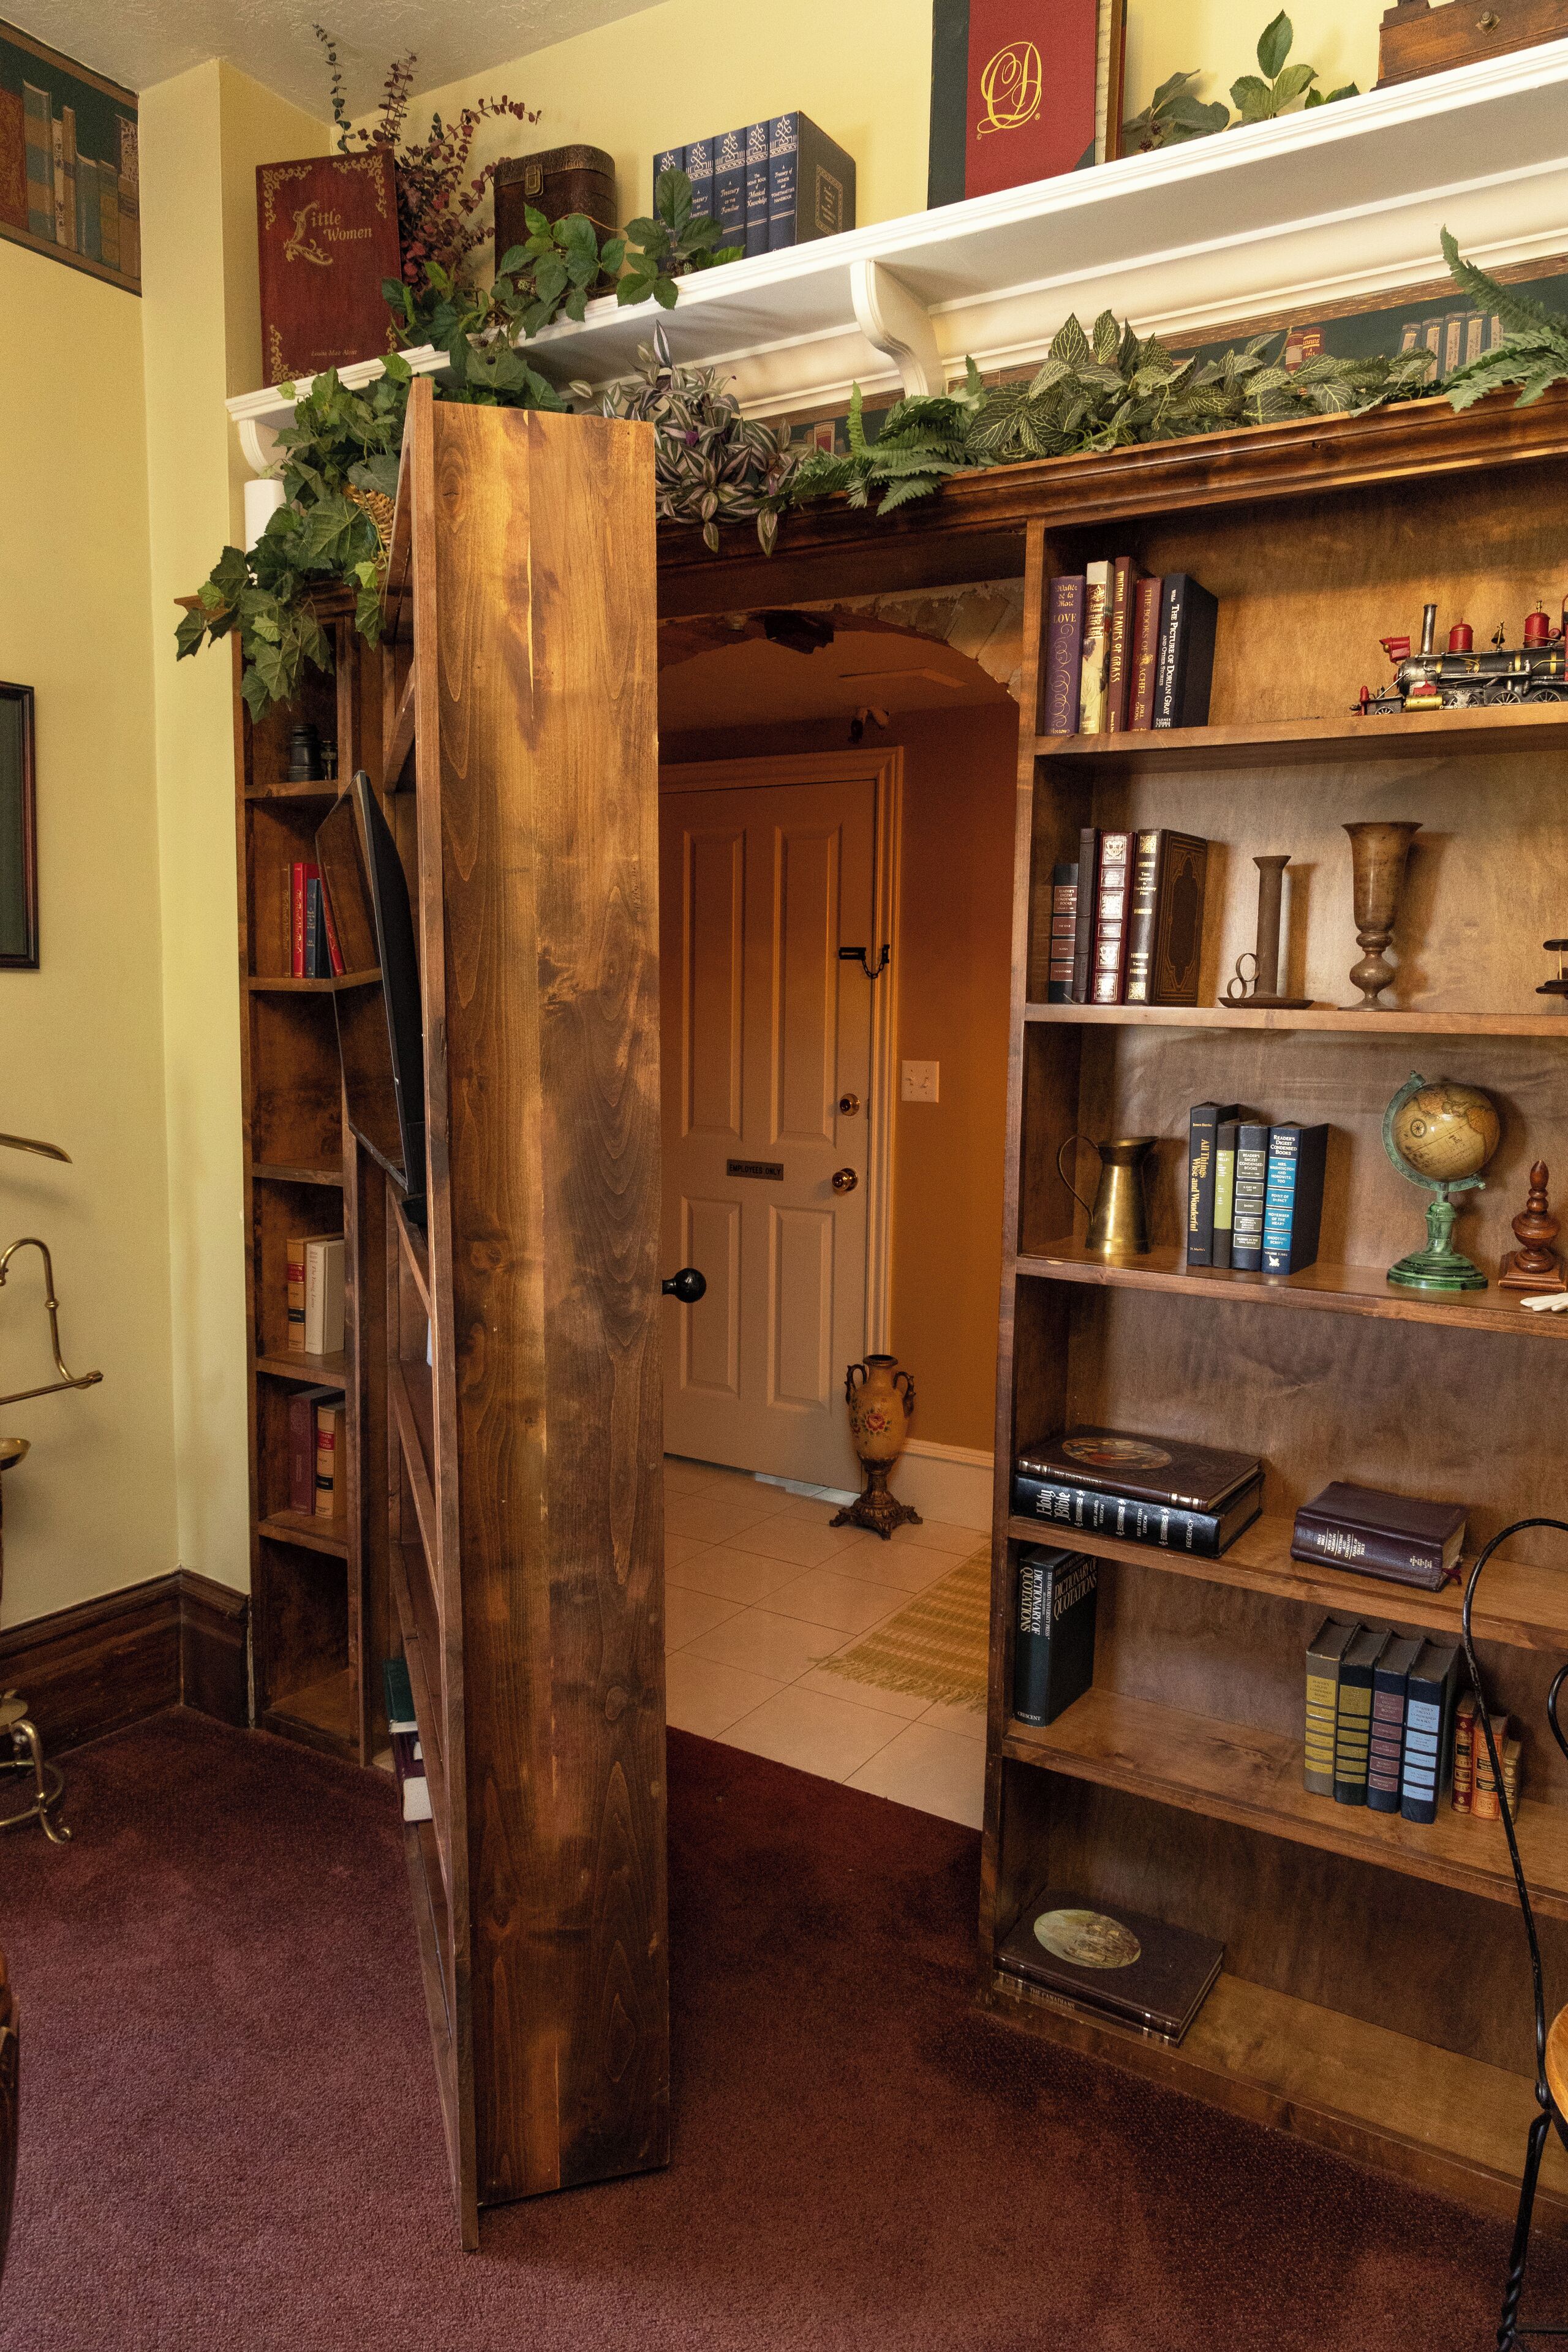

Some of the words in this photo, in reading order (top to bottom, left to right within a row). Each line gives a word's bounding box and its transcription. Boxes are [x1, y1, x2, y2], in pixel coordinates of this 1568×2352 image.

[693, 195, 708, 204] reasury
[720, 187, 740, 197] Treasury
[748, 188, 766, 200] Musical
[774, 194, 792, 203] HANDBOOK
[720, 205, 739, 214] Familiar
[747, 197, 767, 208] Knowledge
[689, 209, 709, 219] American
[284, 200, 342, 266] Little
[323, 227, 372, 241] Women
[1115, 571, 1125, 602] WHITMAN
[1054, 613, 1077, 624] LOVE
[1170, 604, 1180, 620] THE
[1113, 611, 1124, 641] LEAVES
[1142, 609, 1150, 639] BOOKS
[1112, 641, 1122, 653] OF
[1142, 641, 1148, 654] OF
[1169, 621, 1178, 654] PICTURE
[1110, 655, 1121, 683] GRASS
[1167, 654, 1174, 664] OF
[1165, 664, 1175, 696] DORIAN
[1163, 695, 1172, 715] GRAY
[1201, 1139, 1210, 1150] All
[729, 1164, 763, 1174] EMPLOYEES
[1192, 1157, 1201, 1177] Wise
[1199, 1151, 1209, 1178] Things
[1190, 1192, 1200, 1232] Wonderful
[1036, 1489, 1056, 1516] Holy
[1054, 1492, 1071, 1521] Bible
[1186, 1518, 1194, 1548] REGENCY
[1054, 1562, 1088, 1600] DICTIONARY
[1020, 1566, 1034, 1632] QUOTATIONS
[1031, 1569, 1043, 1623] DICTIONARY
[1054, 1570, 1097, 1621] QUOTATIONS
[1031, 1623, 1041, 1635] OF
[1017, 1711, 1041, 1721] CRESCENT
